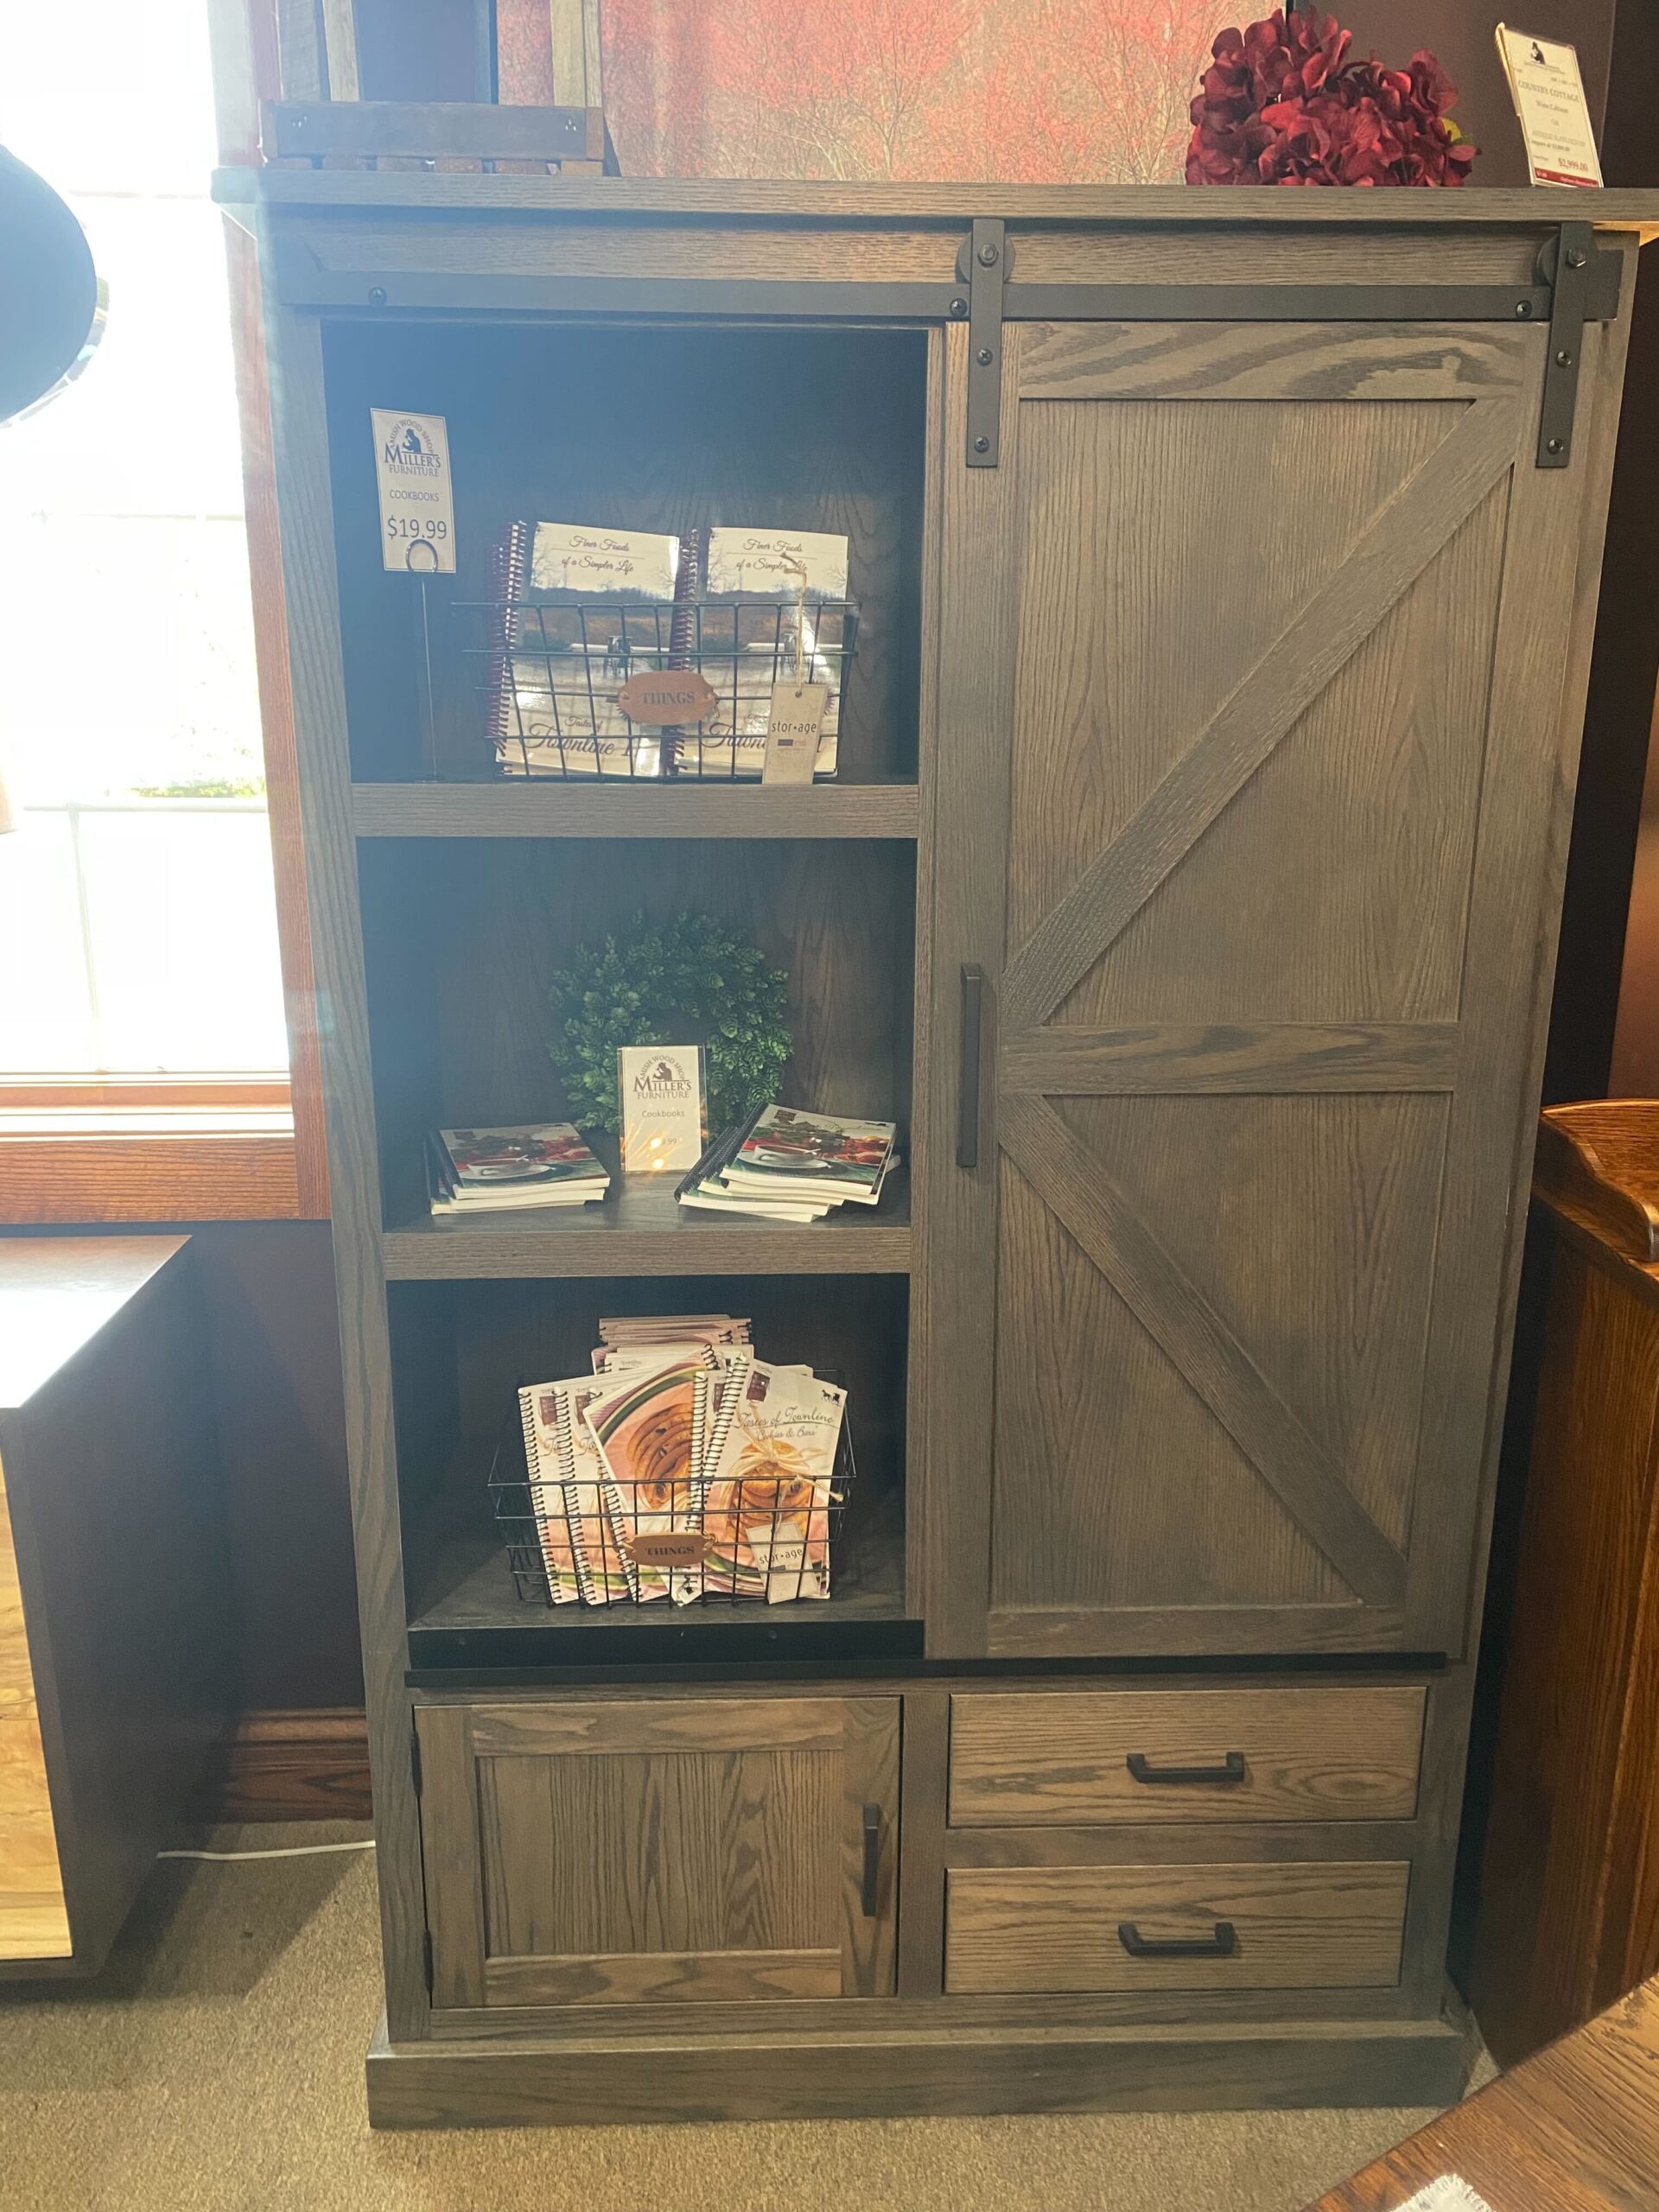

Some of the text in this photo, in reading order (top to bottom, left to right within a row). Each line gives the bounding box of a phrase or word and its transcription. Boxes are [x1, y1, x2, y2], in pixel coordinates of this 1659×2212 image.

[1518, 80, 1548, 96] COUNTRY
[1549, 88, 1580, 103] COTTAGE
[1558, 157, 1589, 172] $2,999.00
[389, 419, 435, 454] AMISH WOOD SHOP
[385, 442, 442, 468] MILLER'S
[389, 464, 440, 477] FURNITURE
[389, 489, 440, 502] COOKBOOKS
[387, 515, 448, 540] $19.99
[569, 535, 630, 551] Finer Foods
[743, 538, 803, 552] Finer Foods
[561, 556, 571, 569] of
[578, 556, 613, 571] Simpler
[615, 559, 634, 575] Life
[735, 559, 747, 571] of
[753, 557, 787, 573] Simpler
[642, 691, 696, 705] THINGS
[525, 723, 615, 755] Townline
[639, 1054, 686, 1081] AMISH WOOD SHOP
[632, 1076, 692, 1092] MILLER'S
[641, 1109, 685, 1118] Cookbooks
[738, 1406, 834, 1428] Tastes of Townline
[757, 1426, 816, 1441] Cookies & Bars
[645, 1546, 695, 1556] THINGS
